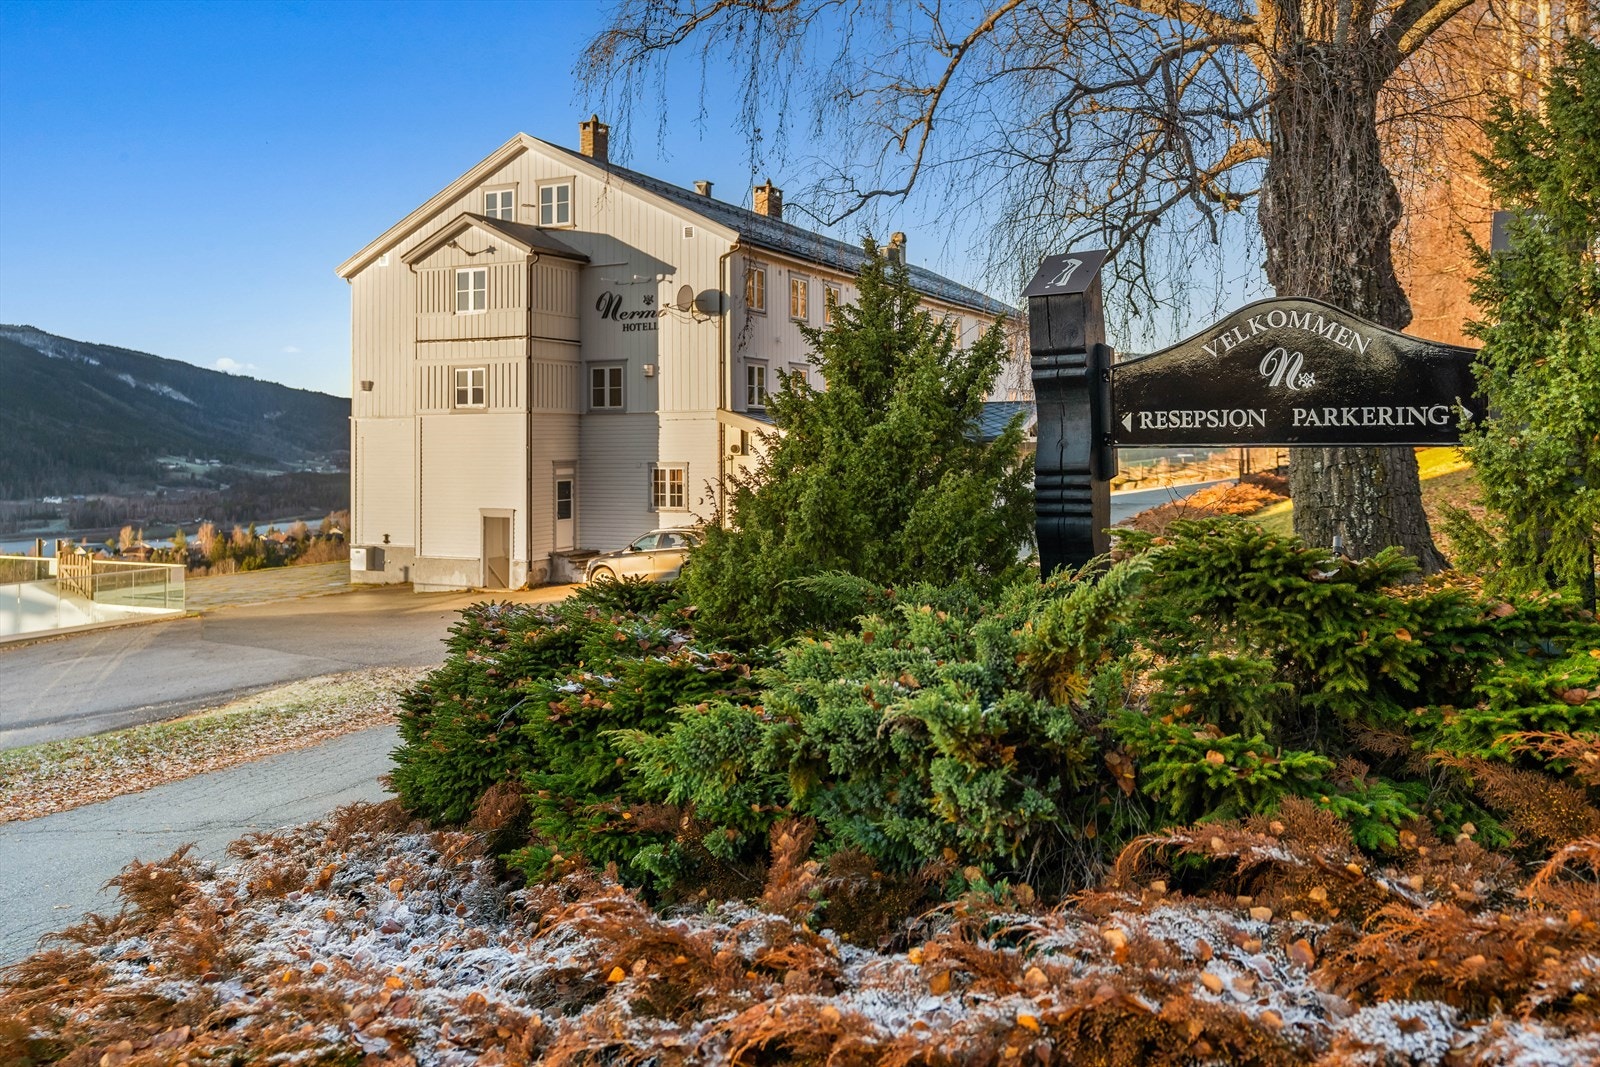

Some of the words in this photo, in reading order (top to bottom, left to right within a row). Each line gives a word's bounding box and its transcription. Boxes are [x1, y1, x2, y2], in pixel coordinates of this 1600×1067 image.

[622, 323, 659, 332] HOTELL
[1201, 310, 1372, 358] VELKOMMEN
[1139, 408, 1267, 429] RESEPSJON
[1292, 405, 1450, 427] PARKERING
